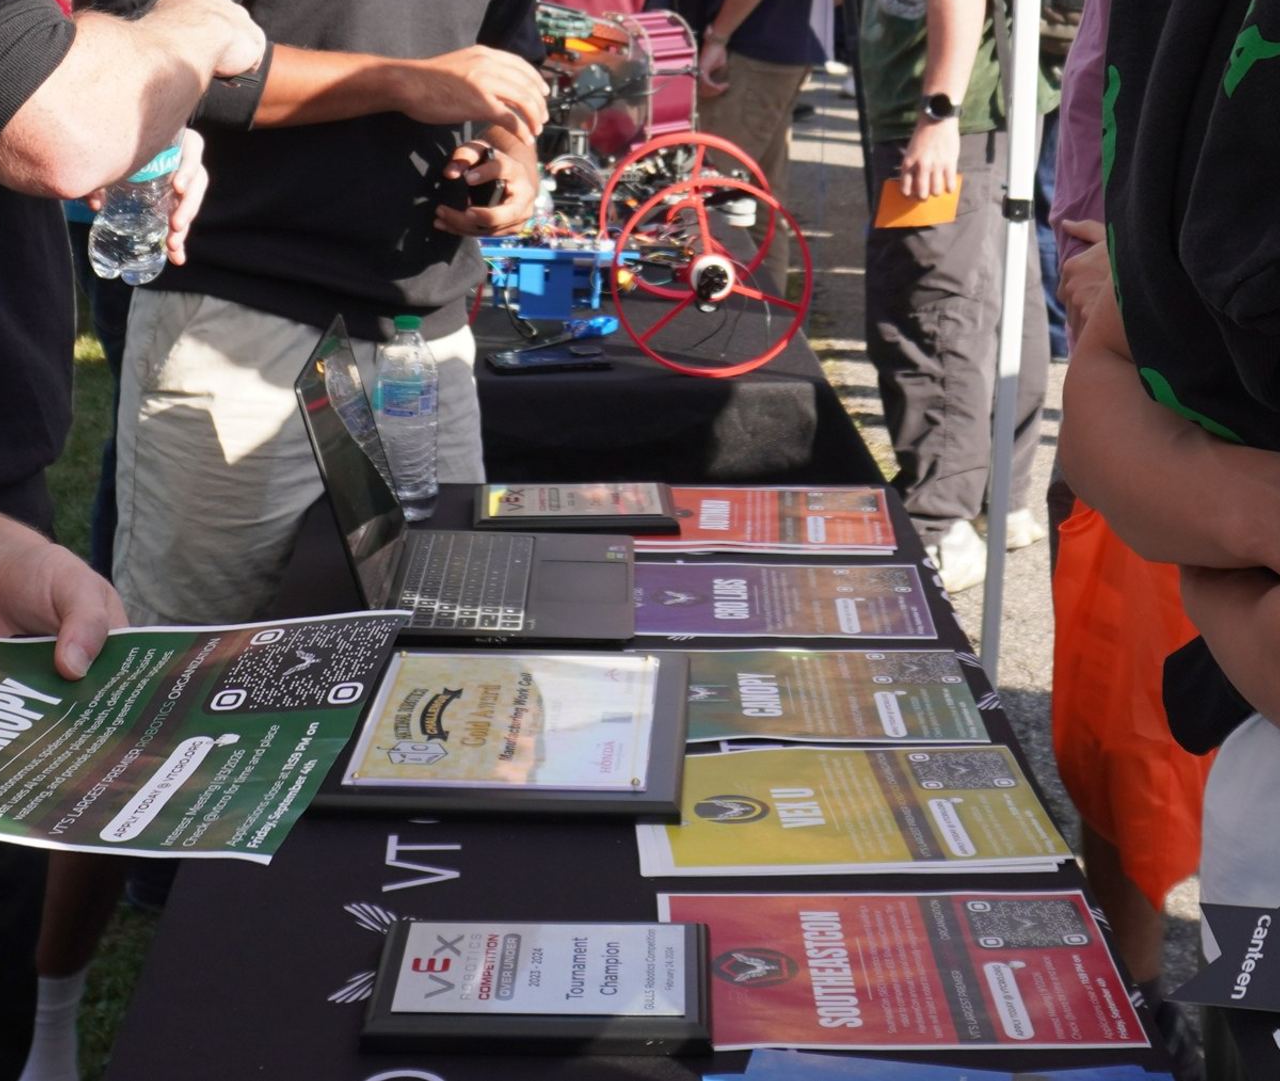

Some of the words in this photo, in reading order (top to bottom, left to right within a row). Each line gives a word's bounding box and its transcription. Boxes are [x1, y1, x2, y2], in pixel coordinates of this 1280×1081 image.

[714, 579, 748, 599] LABS
[714, 600, 749, 619] CRO
[516, 688, 530, 707] Work
[520, 672, 533, 687] Cell
[737, 673, 783, 717] CANOPY
[34, 707, 96, 758] spidercam-style
[44, 775, 67, 789] and
[59, 751, 93, 777] provide
[82, 725, 119, 753] detailed
[109, 675, 153, 726] greenhouse
[67, 780, 108, 819] LARGEST
[100, 745, 143, 784] PREMIER
[132, 698, 177, 748] ROBOTICS
[166, 635, 220, 700] ORGANIZATION
[461, 714, 491, 747] Gold
[477, 685, 502, 715] Award
[499, 706, 527, 762] Manufacturing
[7, 787, 31, 803] uses
[31, 773, 48, 782] to
[40, 749, 76, 774] monitor
[66, 732, 93, 751] plant
[85, 705, 112, 734] health,
[601, 741, 616, 774] HONDA
[180, 821, 211, 847] Check
[222, 782, 240, 795] for
[232, 763, 256, 784] time
[246, 746, 266, 764] and
[258, 722, 281, 748] place
[225, 799, 272, 846] Applications
[262, 778, 284, 801] close
[294, 735, 312, 752] PM
[304, 719, 319, 736] on
[244, 818, 280, 848] Friday,
[268, 773, 309, 821] September
[299, 756, 317, 775] 4th
[770, 788, 814, 798] U
[112, 815, 139, 838] APPLY
[133, 788, 162, 816] TODAY
[160, 815, 193, 846] Interest
[184, 782, 221, 816] Meeting
[775, 801, 826, 828] VEX
[382, 835, 461, 892] VT
[411, 933, 465, 999] VEX
[461, 933, 482, 1000] ROBOTICS
[479, 934, 500, 1000] COMPETITION
[504, 936, 519, 967] UNDER
[531, 947, 544, 965] 2024
[566, 936, 588, 1000] Tournament
[600, 941, 621, 996] Champion
[646, 928, 657, 963] Competition
[798, 911, 863, 1028] SOUTHEASTCON
[1231, 914, 1271, 999] canteen
[500, 968, 515, 997] OVER
[528, 969, 541, 988] 2023
[645, 963, 656, 989] Robotics
